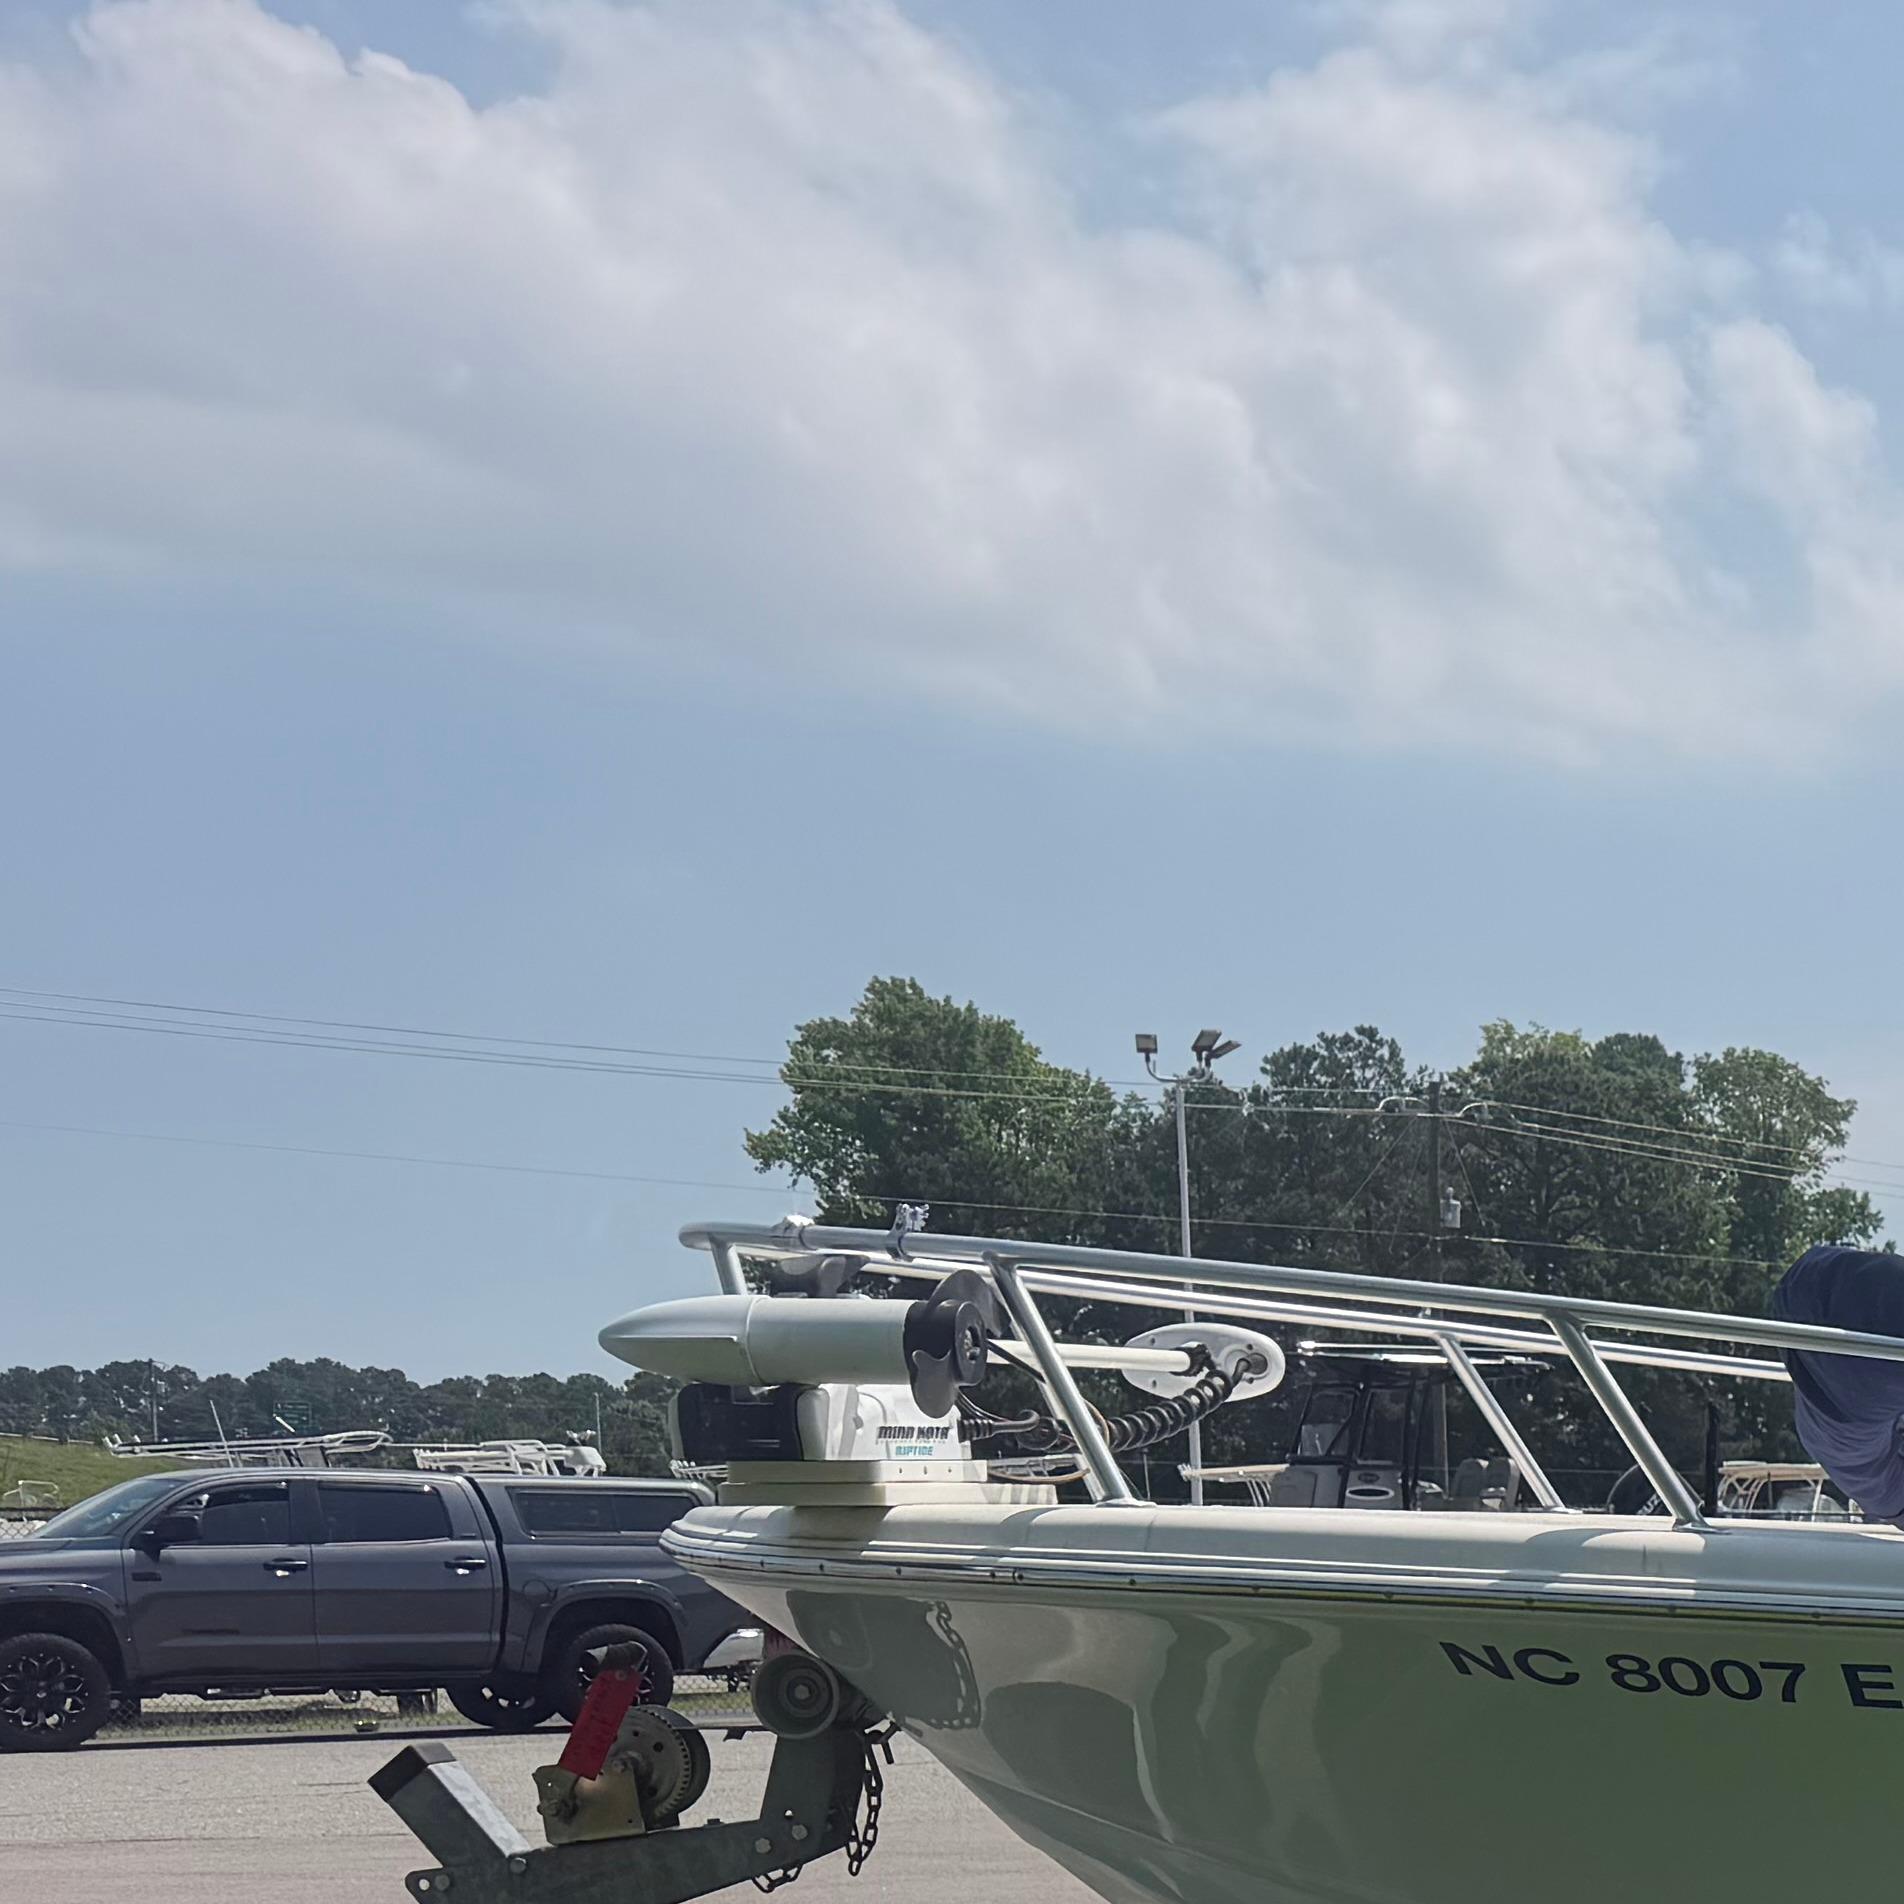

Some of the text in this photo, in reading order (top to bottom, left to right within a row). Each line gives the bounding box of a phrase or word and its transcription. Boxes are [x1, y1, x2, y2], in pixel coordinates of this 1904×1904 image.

[895, 1445, 934, 1456] RIPTIDE
[1438, 1640, 1581, 1687] NC
[1603, 1653, 1807, 1704] 8007
